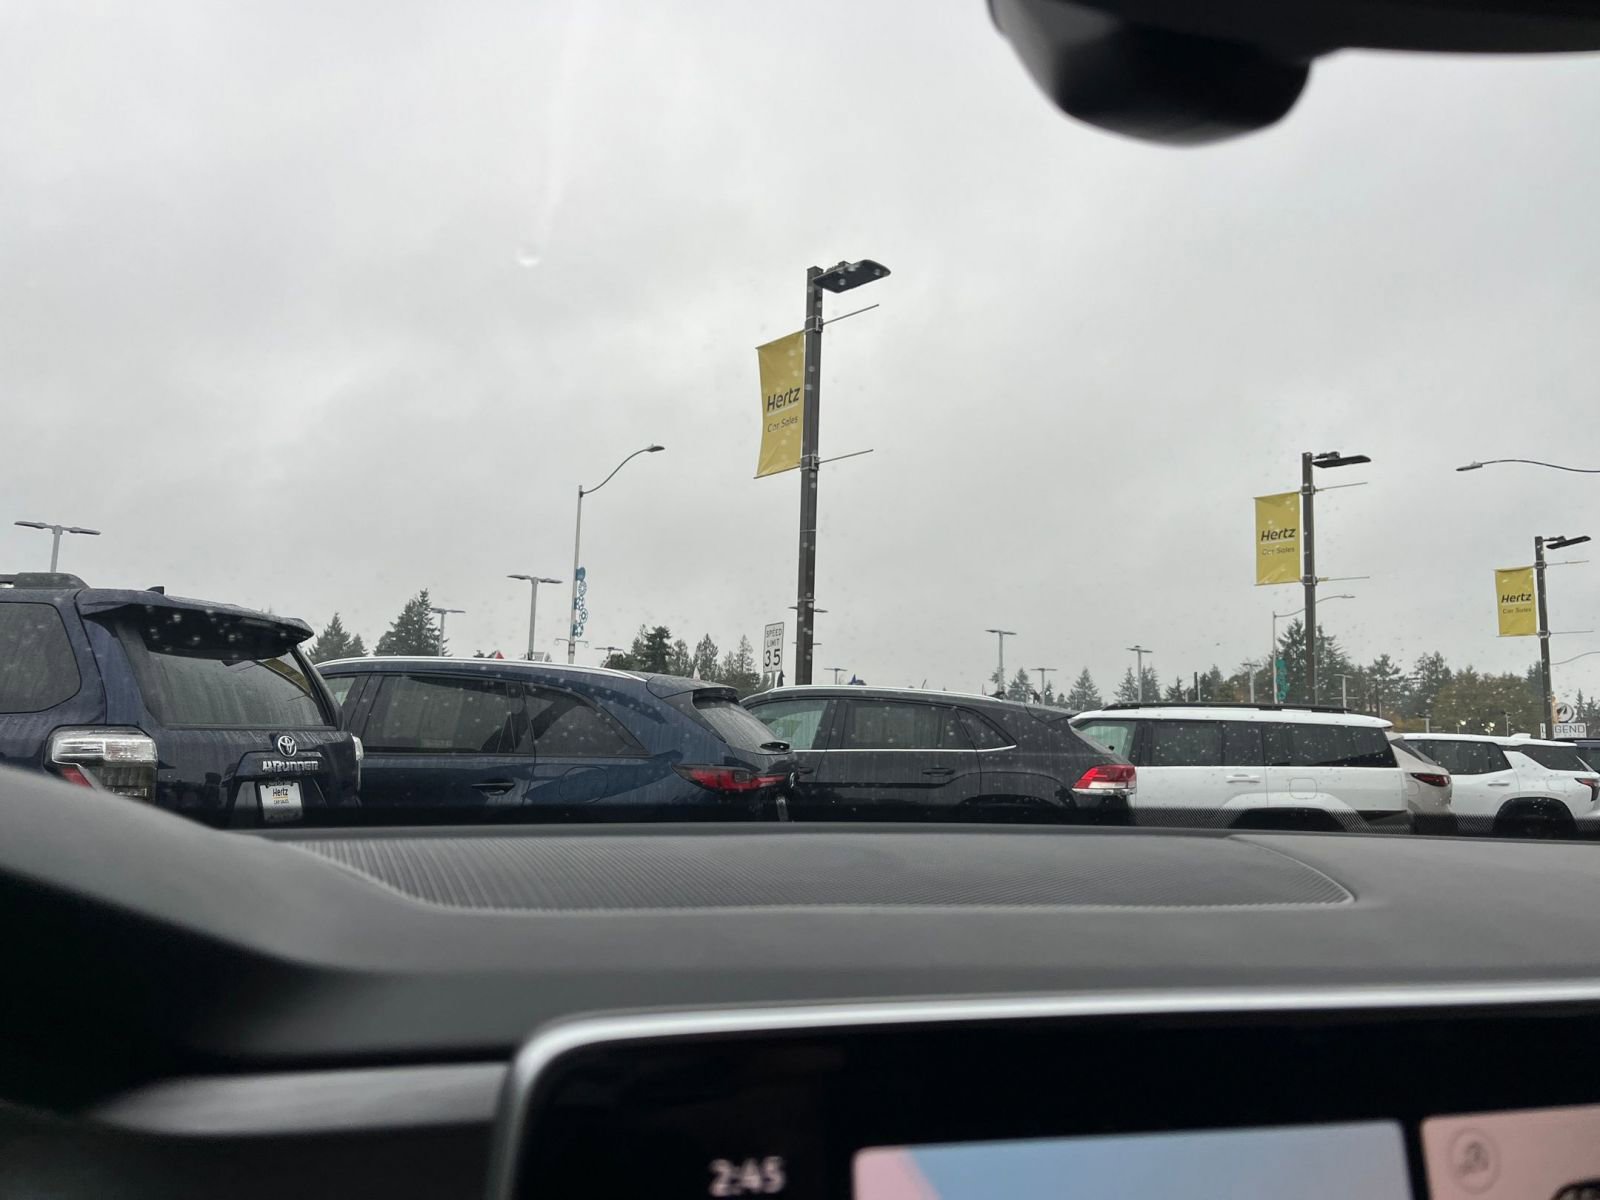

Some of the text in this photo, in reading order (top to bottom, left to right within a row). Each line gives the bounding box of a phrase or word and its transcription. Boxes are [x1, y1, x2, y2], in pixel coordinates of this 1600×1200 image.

[767, 387, 801, 412] Hertz
[767, 416, 799, 433] Car Sales
[1260, 528, 1296, 541] Hertz
[1501, 592, 1532, 603] Hertz
[766, 628, 783, 638] SPEED
[766, 638, 780, 648] LIMIT
[765, 648, 781, 667] 35
[272, 788, 289, 797] Hertz
[709, 1157, 785, 1197] 2:45
